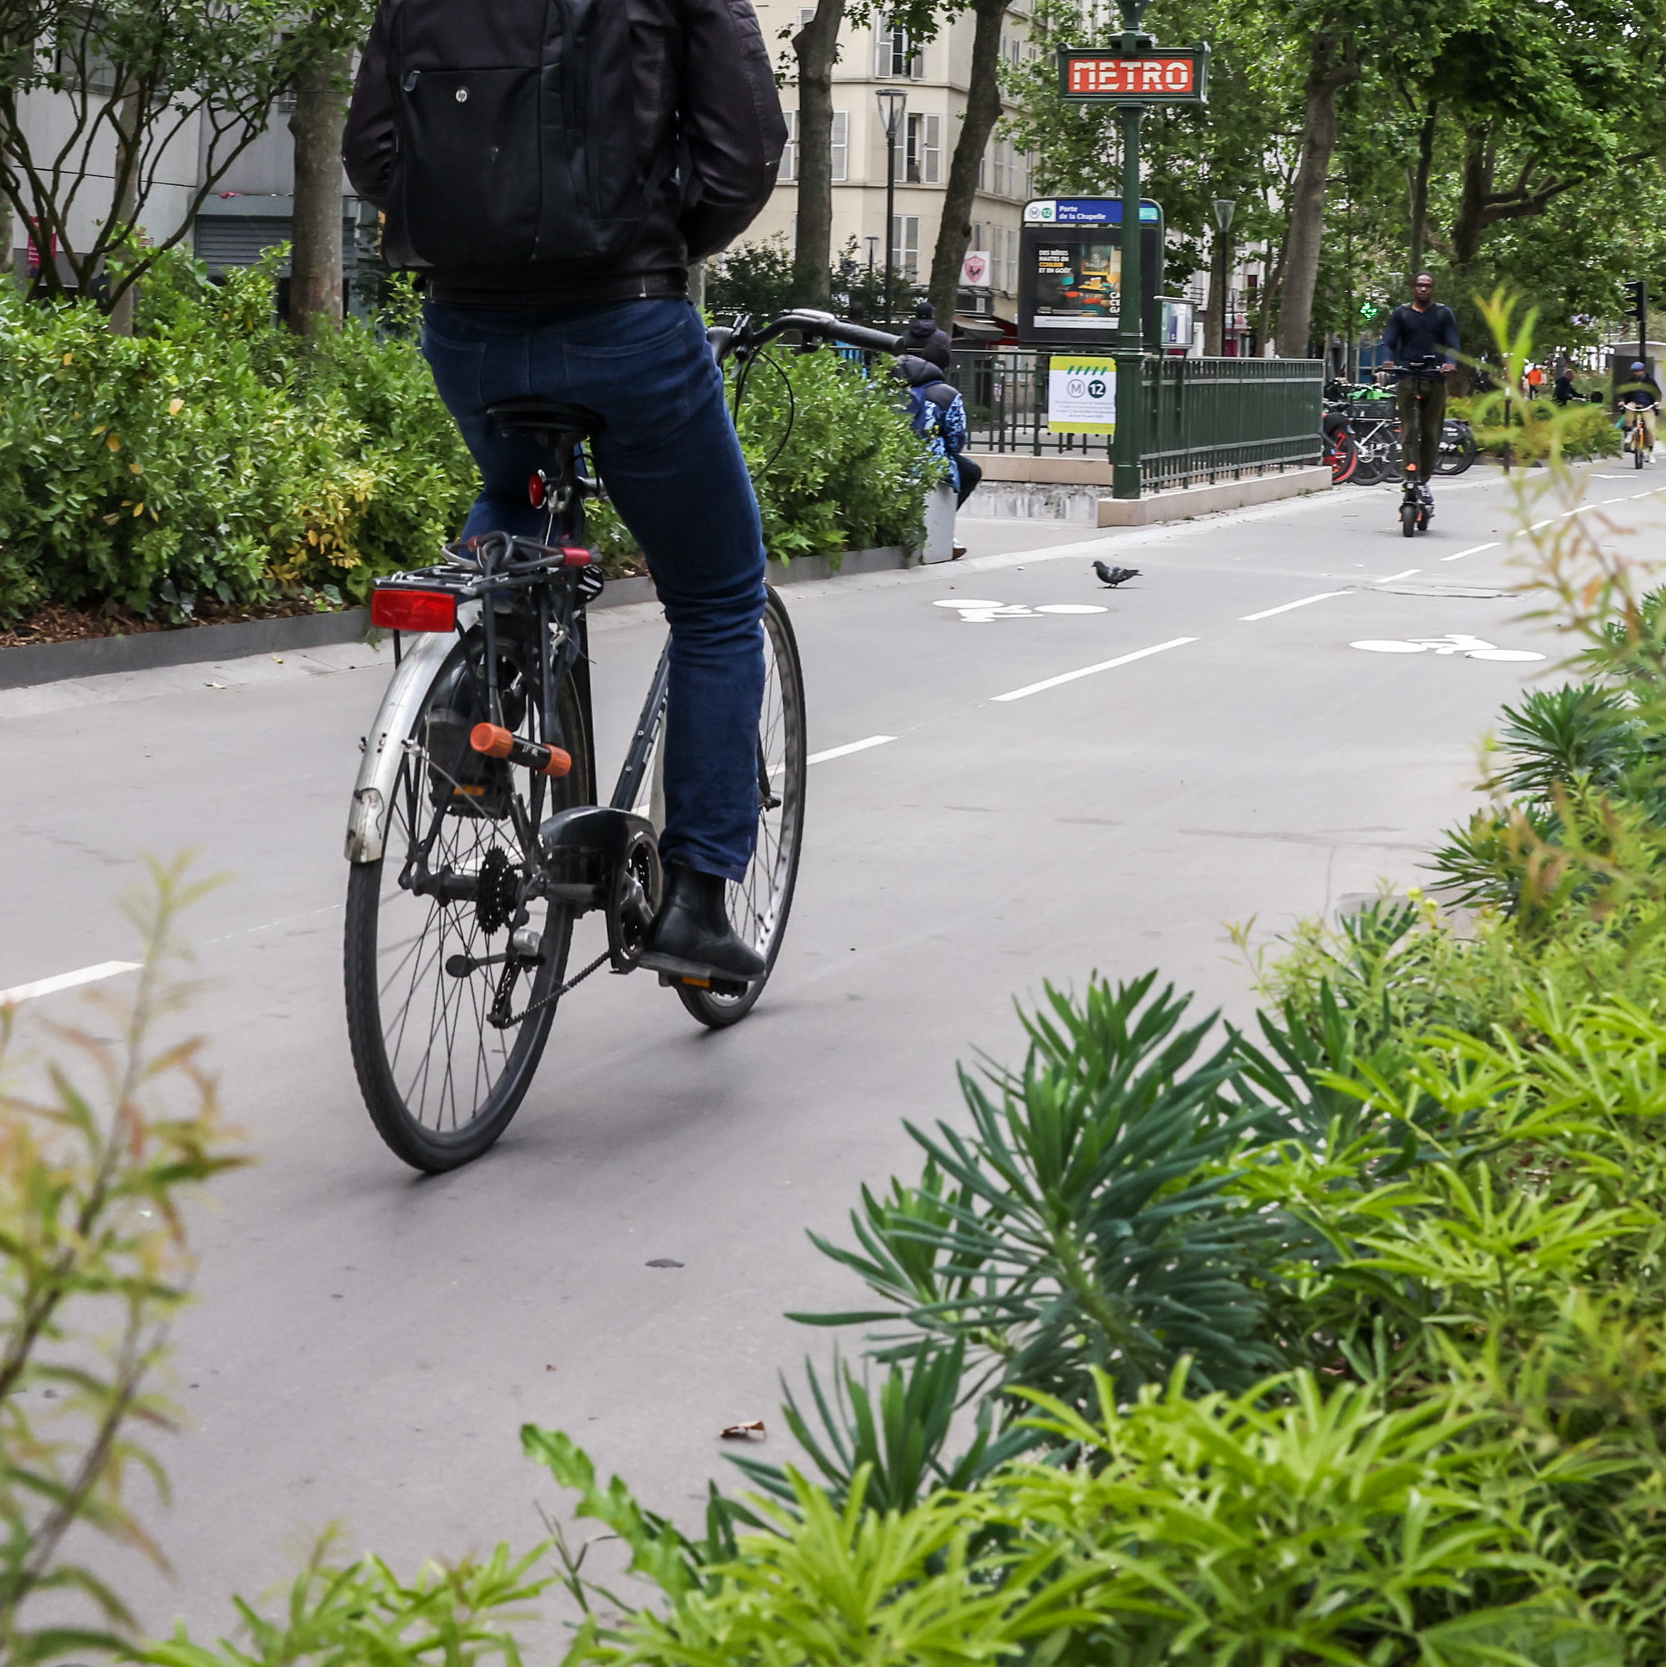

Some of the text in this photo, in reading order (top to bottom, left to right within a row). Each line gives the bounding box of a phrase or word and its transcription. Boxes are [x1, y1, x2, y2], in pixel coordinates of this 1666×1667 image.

[1073, 61, 1188, 90] METRO
[1076, 213, 1106, 221] Chapelle
[1089, 383, 1104, 395] 12
